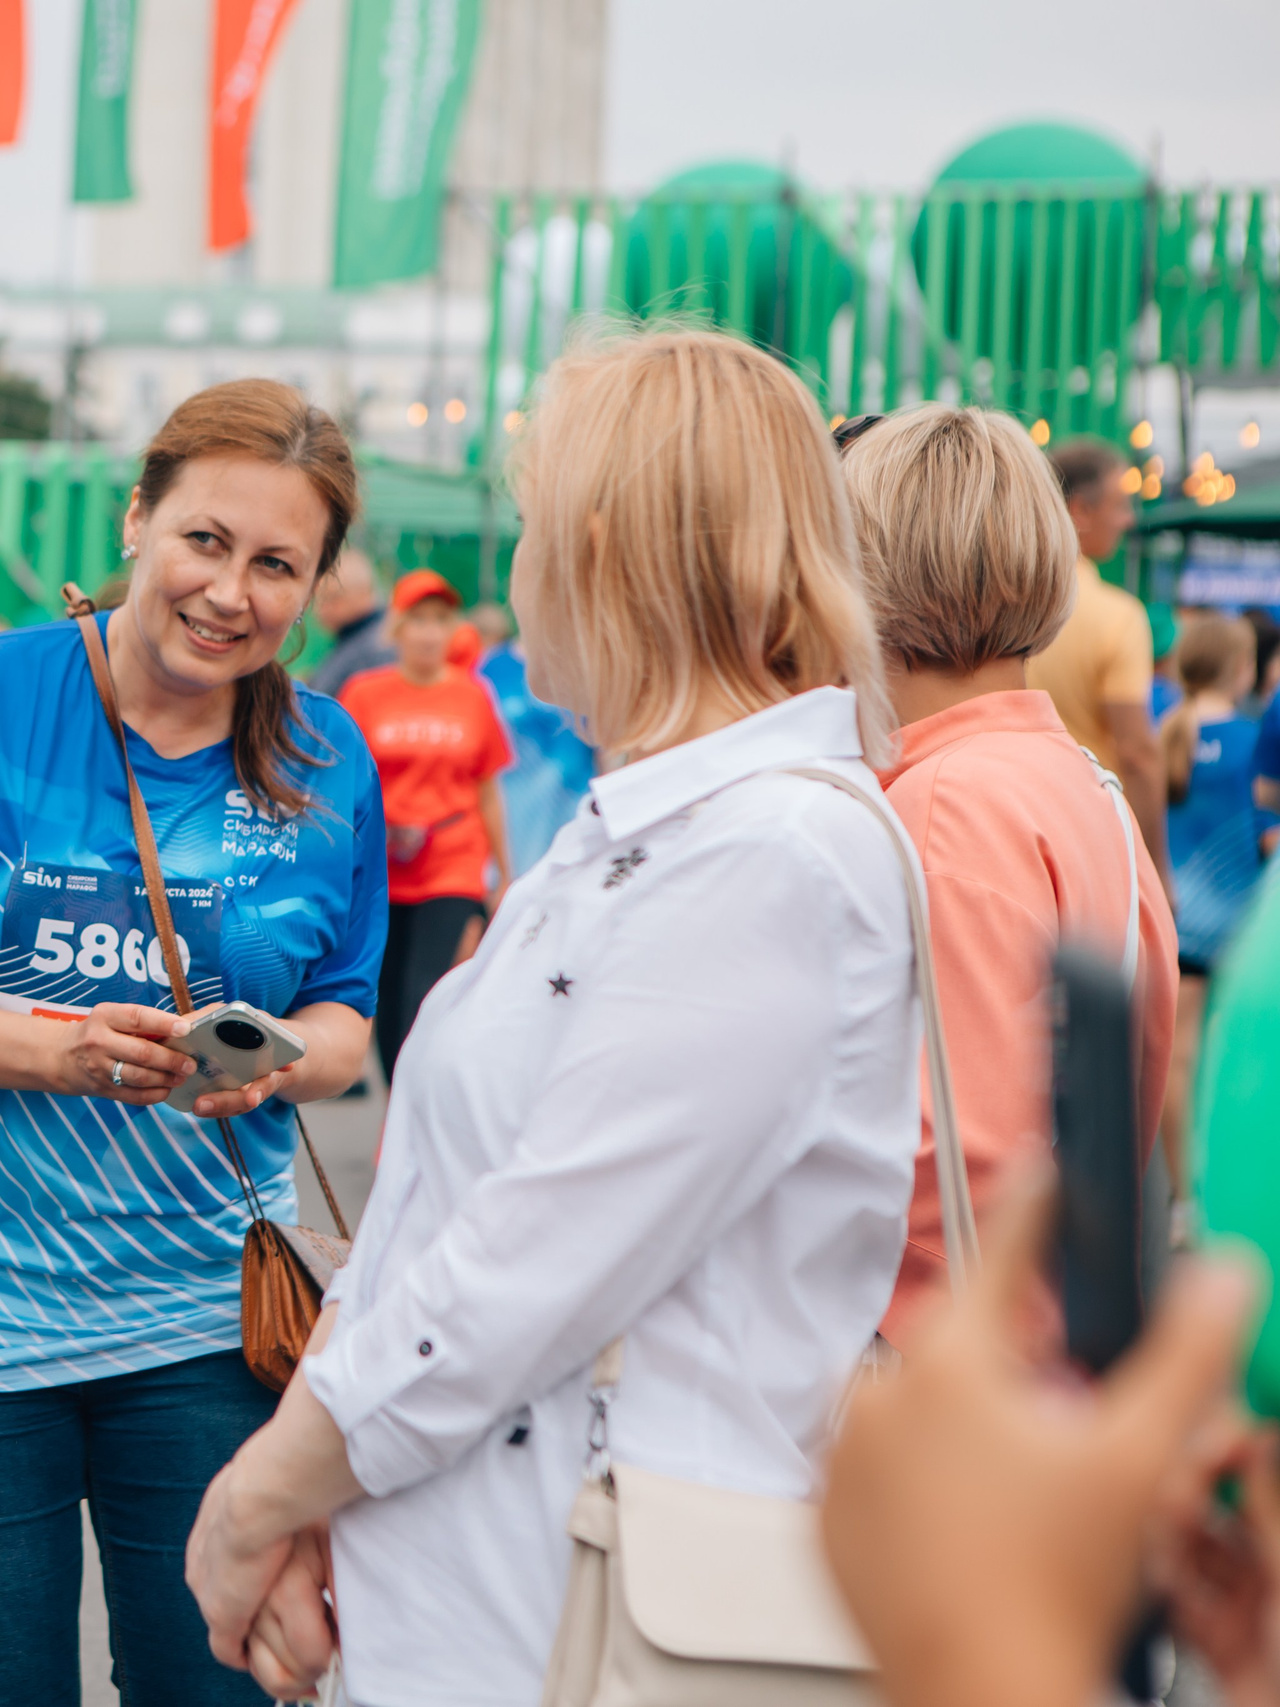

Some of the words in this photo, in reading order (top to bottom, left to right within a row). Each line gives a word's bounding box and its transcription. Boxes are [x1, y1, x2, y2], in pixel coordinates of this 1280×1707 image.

[224, 875, 259, 890] ОСК
[134, 886, 141, 896] 3
[188, 887, 214, 898] 2024
[192, 899, 198, 908] 3
[29, 917, 191, 988] 5860
